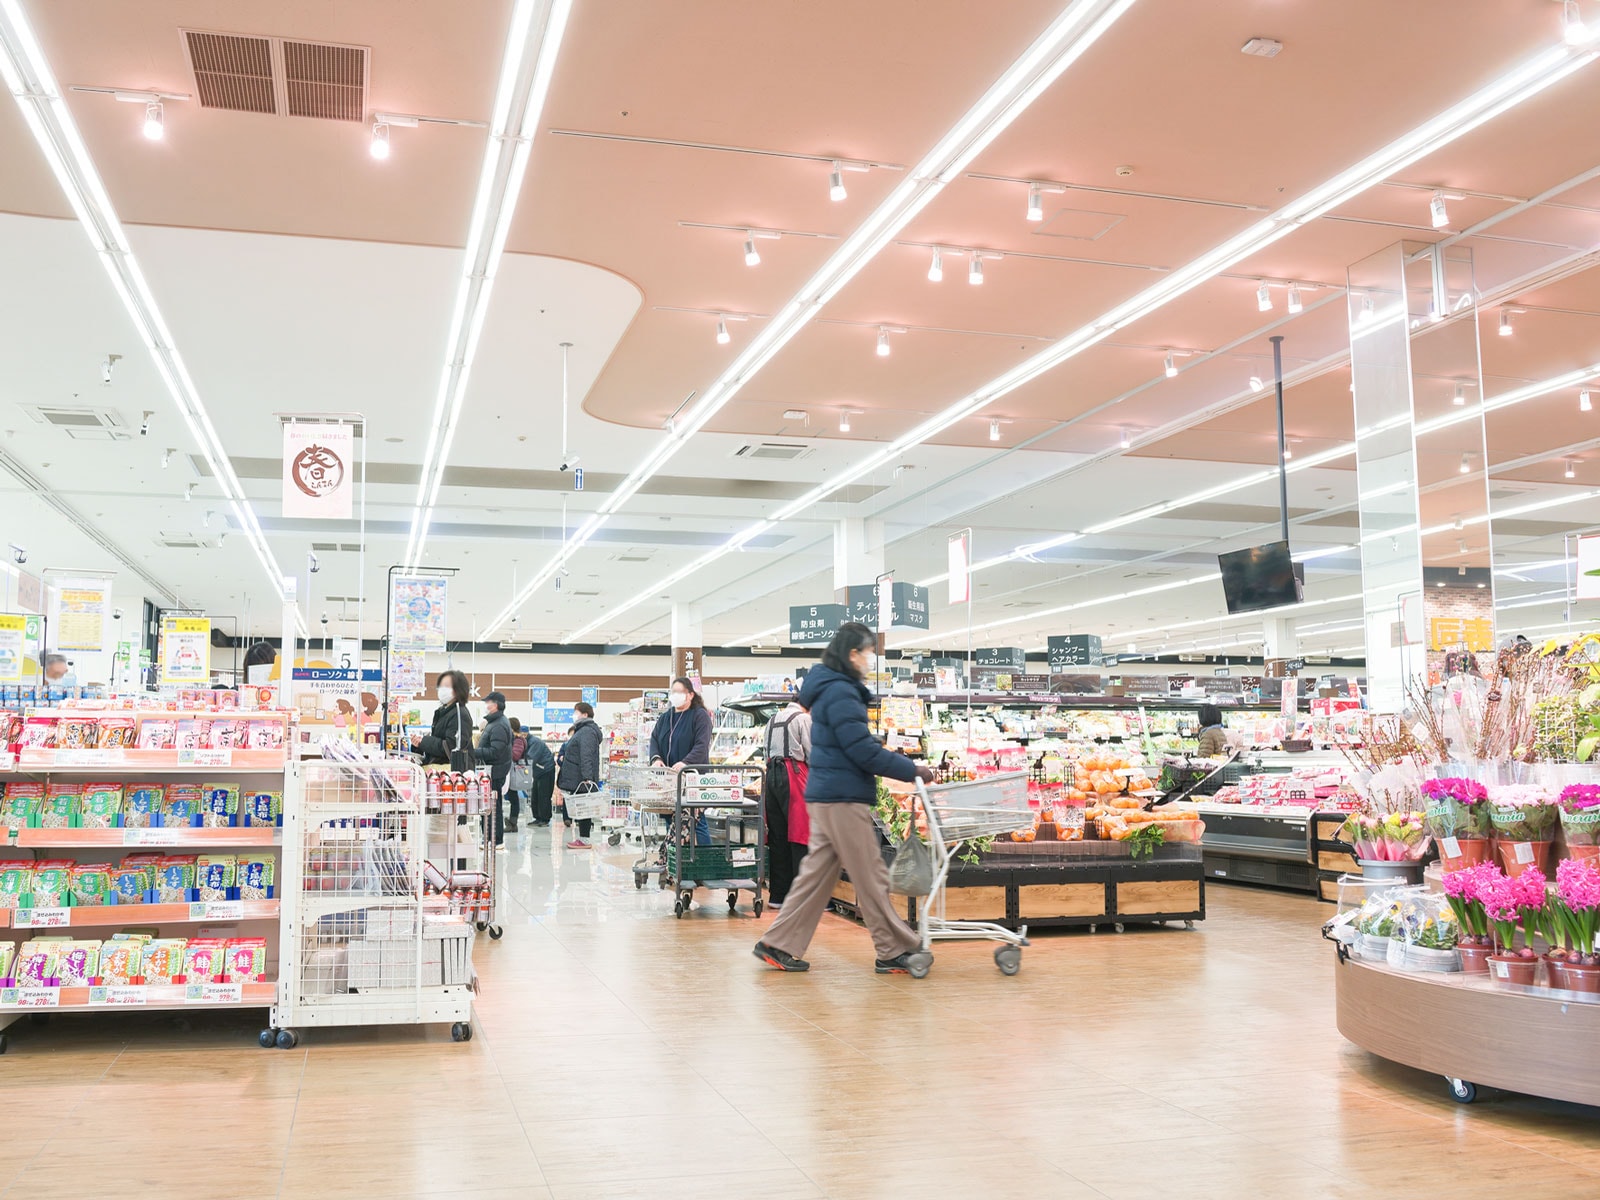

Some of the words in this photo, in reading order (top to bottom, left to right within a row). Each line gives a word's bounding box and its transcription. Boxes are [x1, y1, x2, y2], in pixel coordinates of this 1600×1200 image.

[300, 443, 337, 481] 春
[913, 587, 918, 597] 6
[856, 601, 896, 611] ティッュ
[810, 607, 817, 617] 5
[852, 614, 899, 624] トイレル
[909, 613, 923, 624] マスク
[800, 619, 825, 629] 防虫剤
[1064, 636, 1071, 644] 4
[992, 648, 998, 656] 3
[1051, 646, 1085, 655] シャンプー
[340, 653, 351, 669] 5
[978, 657, 1011, 665] チョコレート
[1051, 655, 1085, 663] ヘアカラー
[237, 954, 251, 968] 鮭
